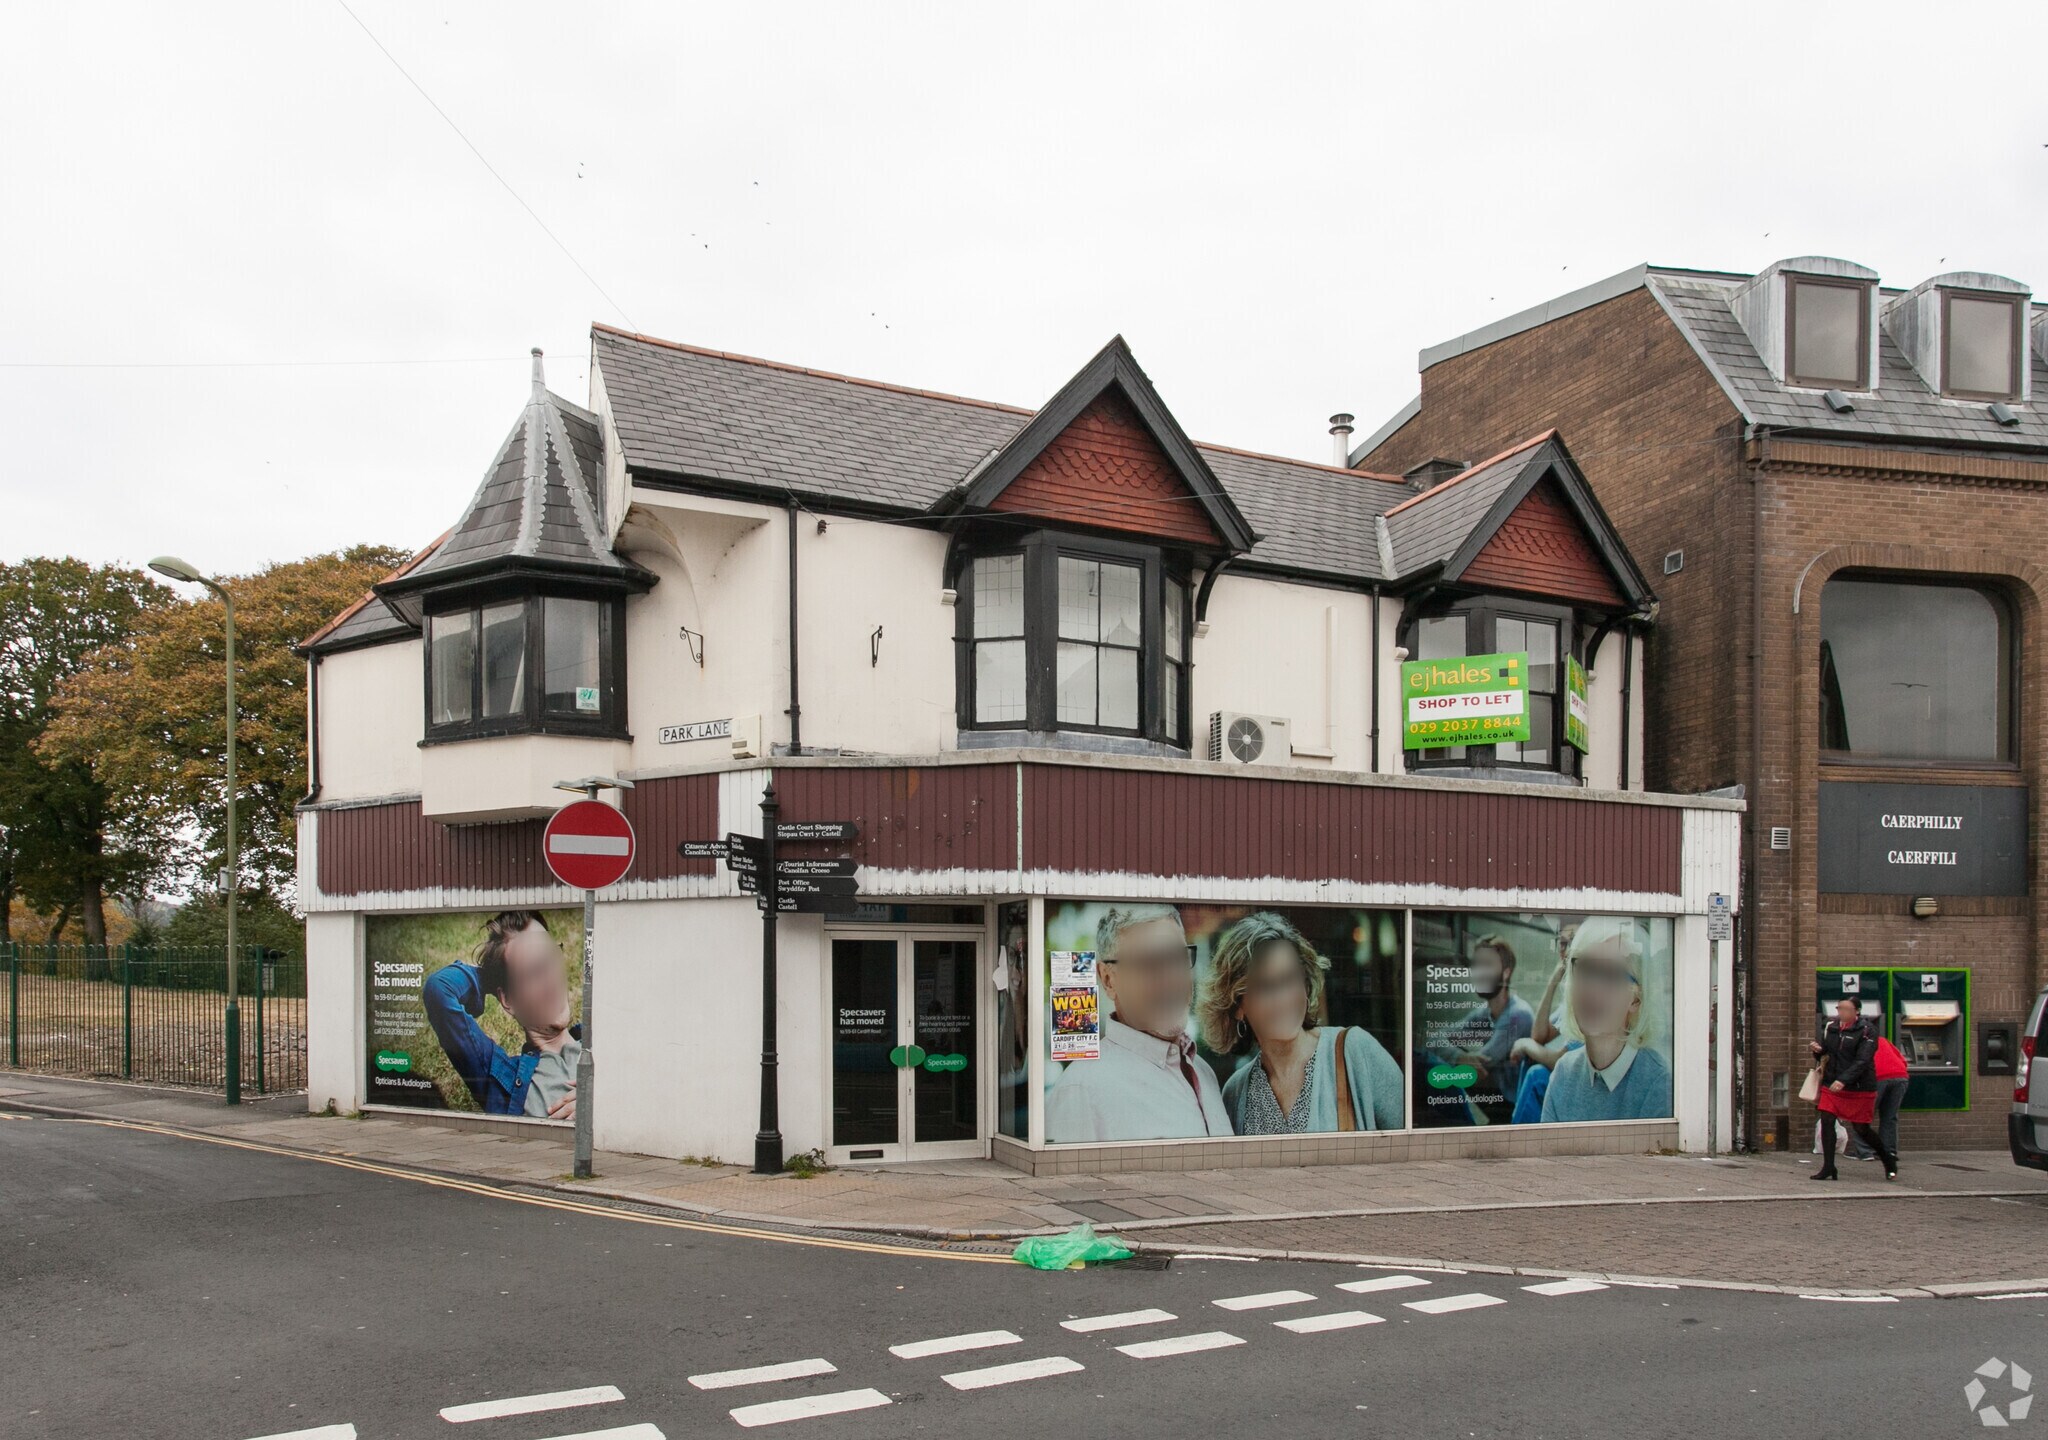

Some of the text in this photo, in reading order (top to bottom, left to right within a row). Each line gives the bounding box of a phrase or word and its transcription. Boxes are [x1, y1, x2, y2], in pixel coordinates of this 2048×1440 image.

[1410, 663, 1492, 693] ejhales
[1418, 695, 1512, 709] SHOP TO LET
[1410, 716, 1521, 734] 029 2037 8844
[664, 722, 729, 741] PARK LANE
[1422, 730, 1514, 743] www.ejhales.co.uk
[1881, 814, 1963, 829] CAERPHILLY
[1888, 851, 1956, 865] CAERFFILI
[374, 961, 424, 975] Specsavers
[374, 975, 422, 987] has moved
[1427, 980, 1477, 993] has mov
[1053, 994, 1097, 1010] WOW
[1426, 1001, 1433, 1009] to
[1452, 1001, 1471, 1009] Cardiff
[840, 1008, 886, 1017] Specsavers
[840, 1017, 884, 1025] has moved
[1455, 1021, 1469, 1029] sight
[1439, 1031, 1462, 1039] hearing
[1475, 1030, 1493, 1038] please
[378, 1056, 408, 1065] Specsavers
[928, 1059, 963, 1067] Specsavers
[375, 1077, 397, 1086] Opticians
[402, 1079, 431, 1089] Audiologists
[1432, 1072, 1473, 1082] Specsavers
[1428, 1094, 1503, 1106] Opticians & Audiologists
